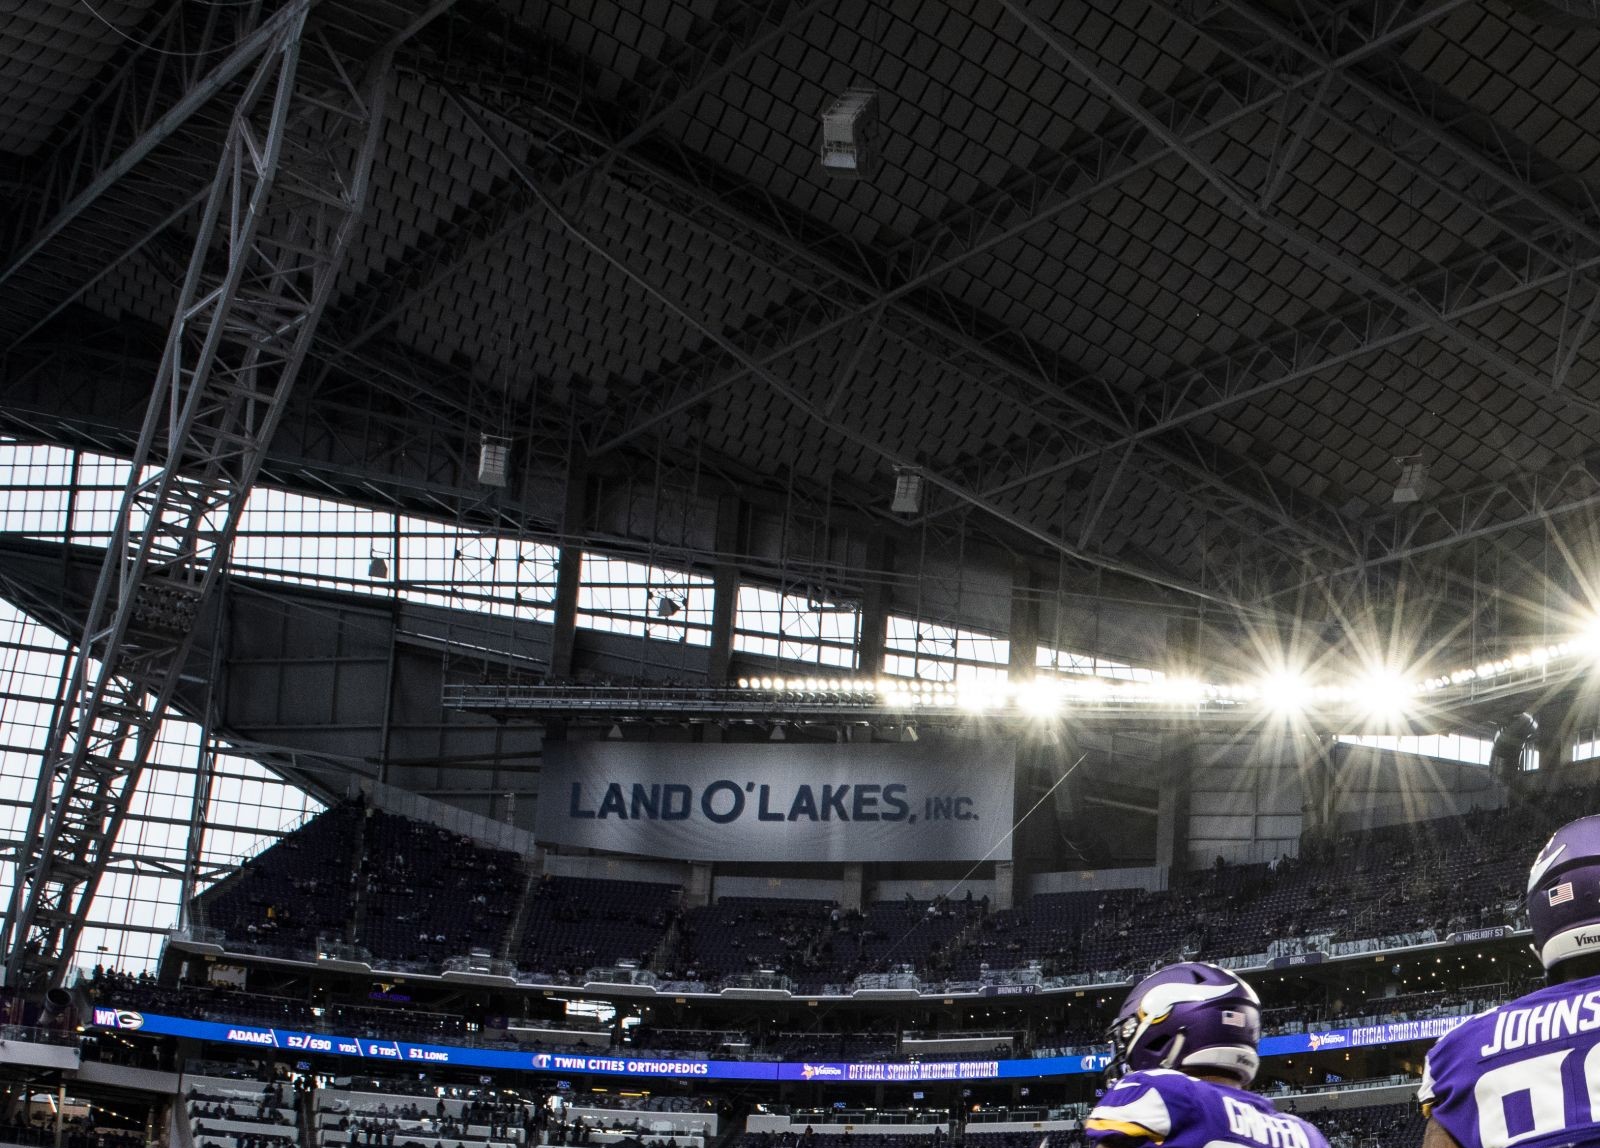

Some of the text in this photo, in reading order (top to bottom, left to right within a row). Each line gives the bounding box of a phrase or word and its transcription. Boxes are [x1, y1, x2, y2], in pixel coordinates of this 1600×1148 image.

[569, 782, 691, 821] LAND
[923, 796, 979, 822] INC.
[1462, 931, 1494, 942] TINGELHOFF
[1025, 985, 1034, 994] 47
[94, 1008, 114, 1026] WR
[227, 1029, 272, 1044] ADAMS
[1352, 1026, 1386, 1045] OFFICIAL
[1388, 1022, 1418, 1041] SPORTS
[288, 1034, 357, 1054] 52/690 YDS
[369, 1045, 397, 1056] 6 TDS
[409, 1048, 449, 1061] 51 LONG
[554, 1057, 708, 1075] TWIN CITIES ORTHOPEDICS
[849, 1062, 998, 1080] OFFICIAL SPORTS MEDICINE PROVIDER
